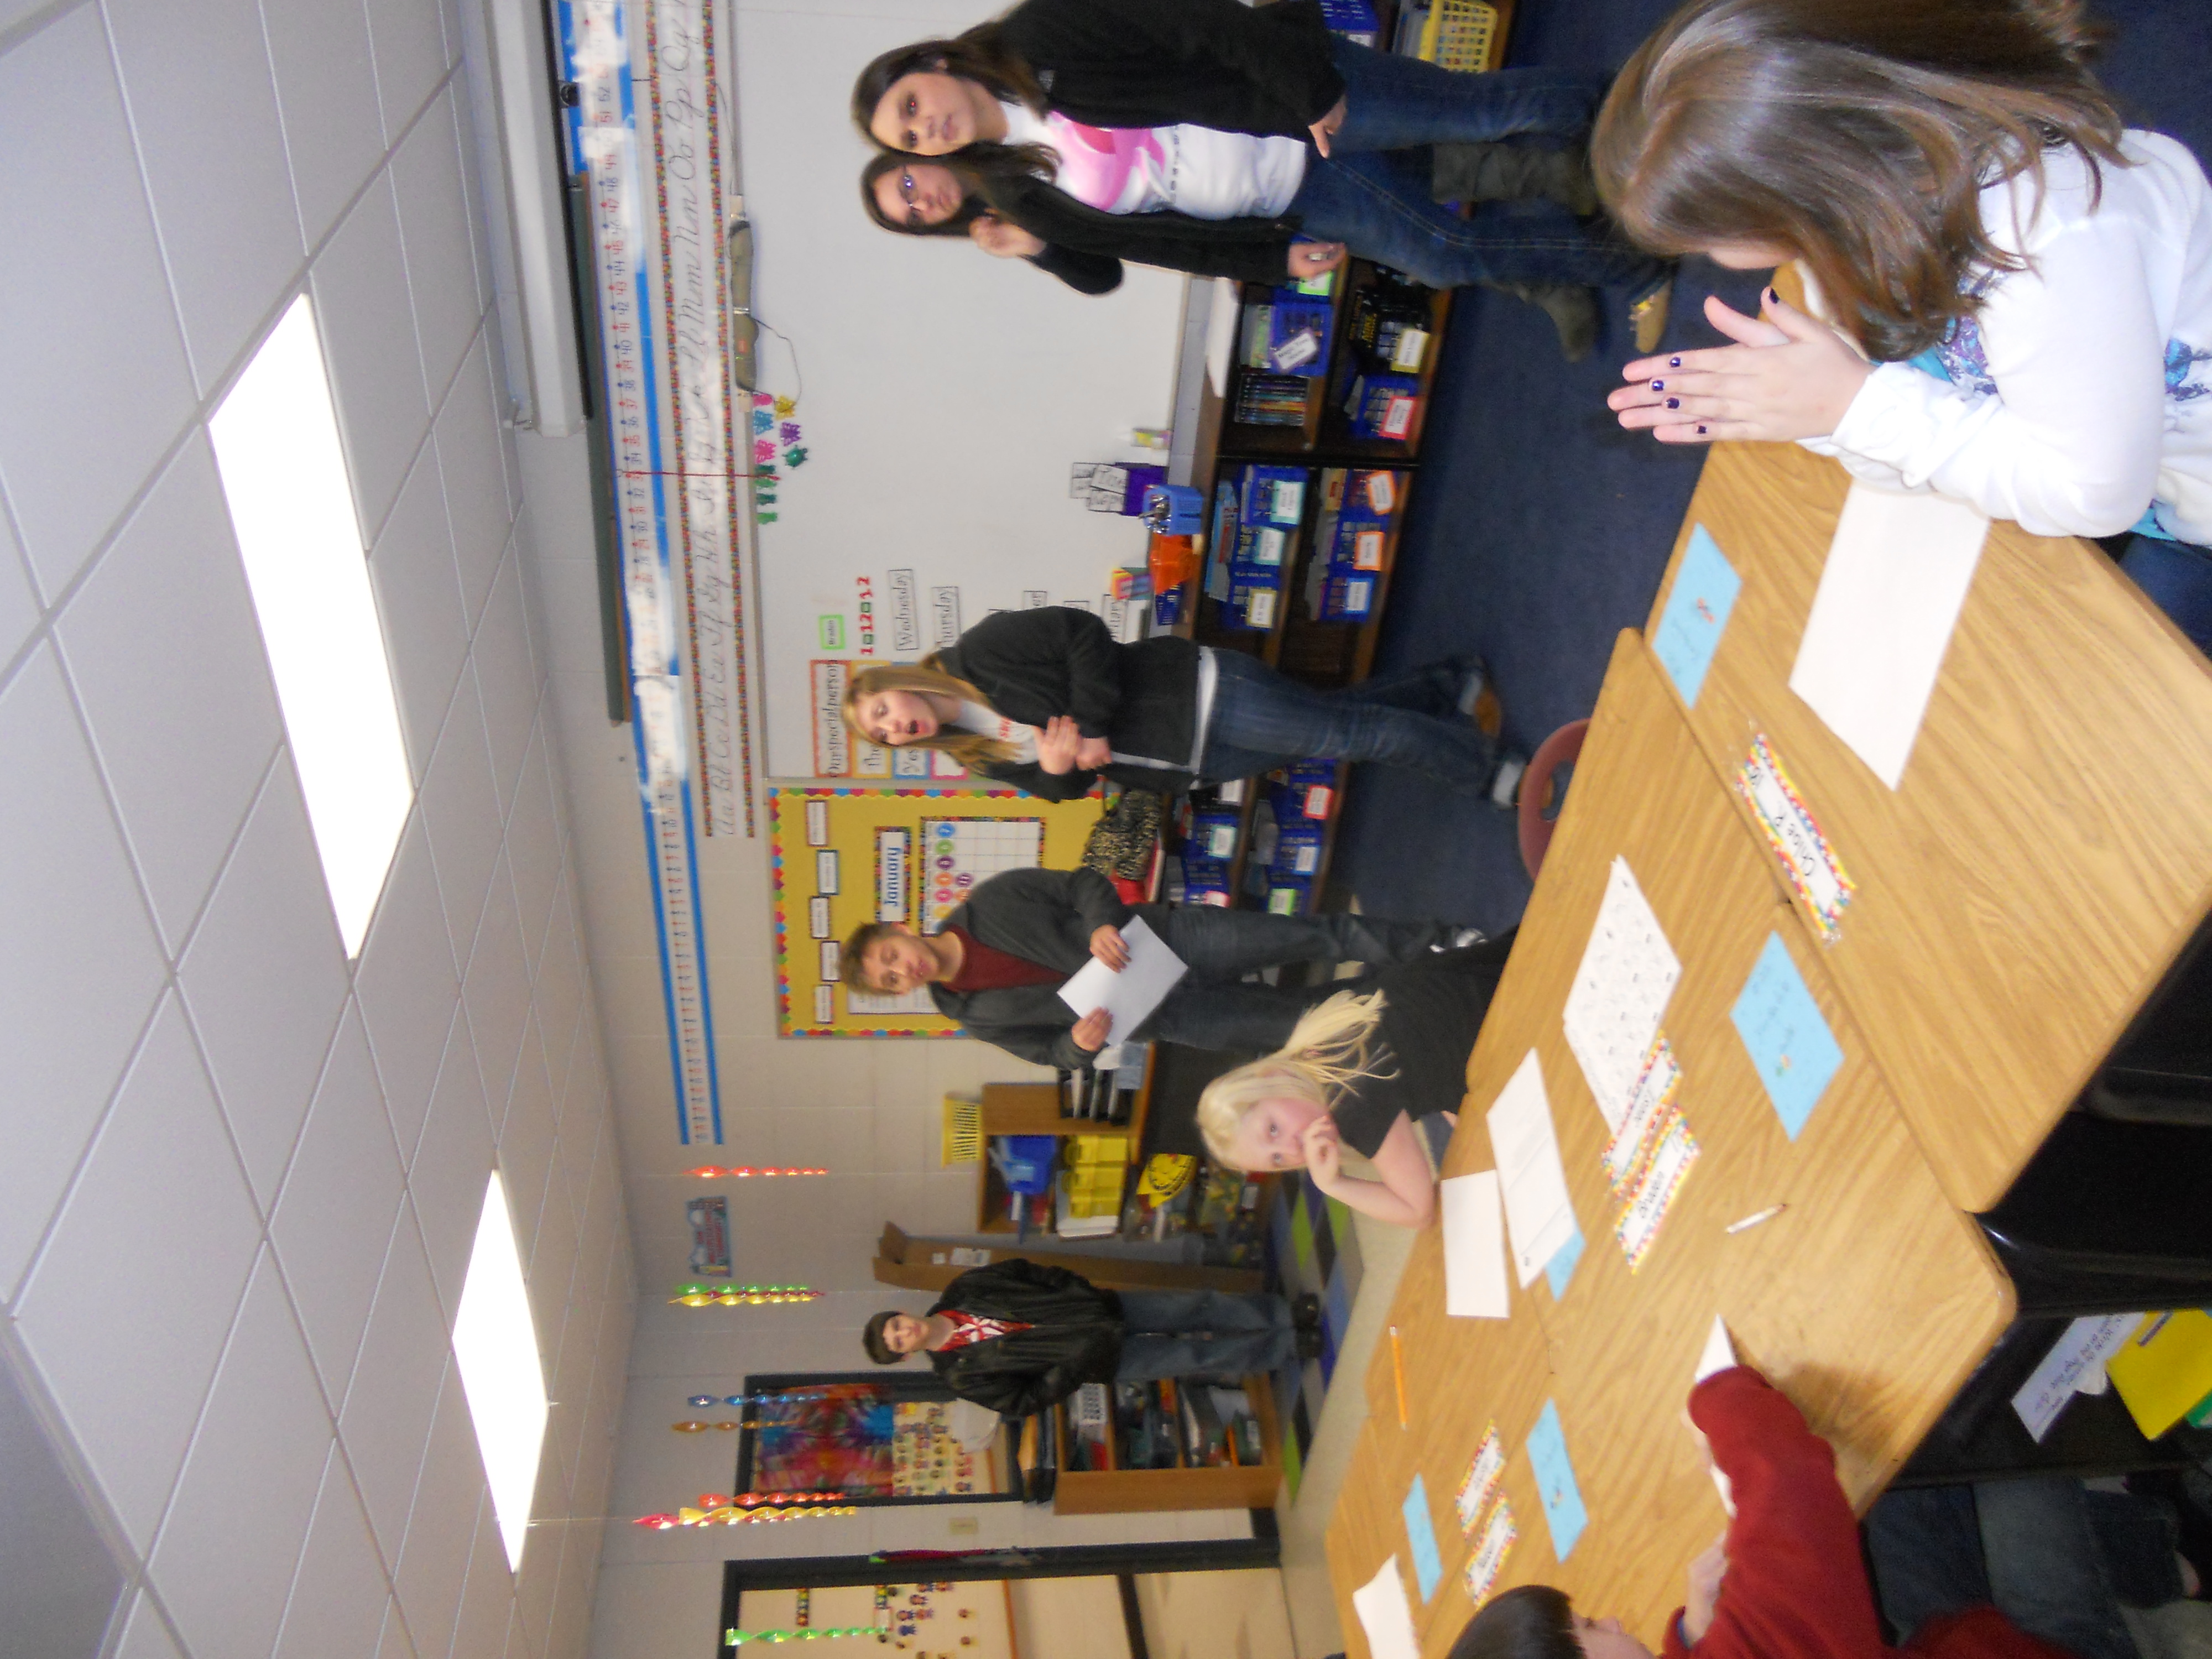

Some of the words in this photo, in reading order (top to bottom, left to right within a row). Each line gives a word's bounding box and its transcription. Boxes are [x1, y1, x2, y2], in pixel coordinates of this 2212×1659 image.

[598, 86, 612, 102] 52
[599, 111, 613, 123] 51
[603, 154, 617, 170] 49
[606, 177, 618, 192] 48
[608, 197, 620, 213] 47
[613, 260, 625, 275] 44
[615, 281, 628, 295] 43
[617, 301, 630, 315] 42
[620, 340, 633, 355] 40
[890, 573, 912, 646] Wednesday
[1786, 822, 1816, 877] Chloe
[884, 846, 904, 907] January
